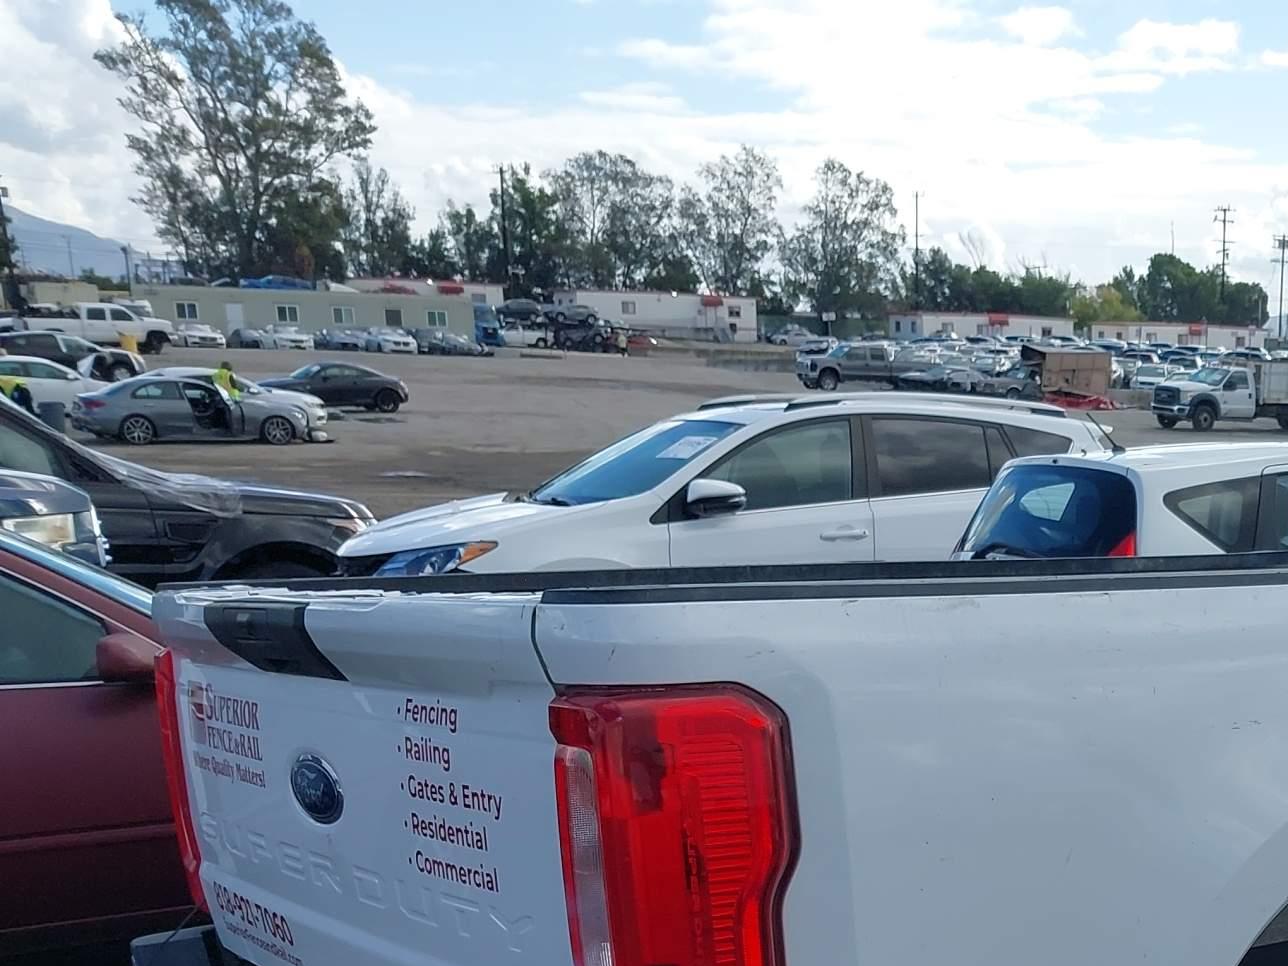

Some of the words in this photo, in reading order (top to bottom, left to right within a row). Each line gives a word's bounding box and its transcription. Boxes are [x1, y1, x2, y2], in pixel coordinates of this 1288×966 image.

[205, 683, 261, 731] SUPERIOR
[404, 698, 458, 734] Fencing
[211, 756, 234, 784] Quality
[235, 763, 266, 789] Matters!
[404, 736, 450, 772] Railing
[408, 774, 446, 804] Gates
[448, 782, 459, 806] &
[462, 784, 502, 821] Entry
[411, 812, 489, 852] Residential
[199, 812, 343, 894] SUPER
[352, 864, 535, 952] DUTY
[415, 850, 500, 893] Commercial
[213, 880, 295, 947] 818-921-7060
